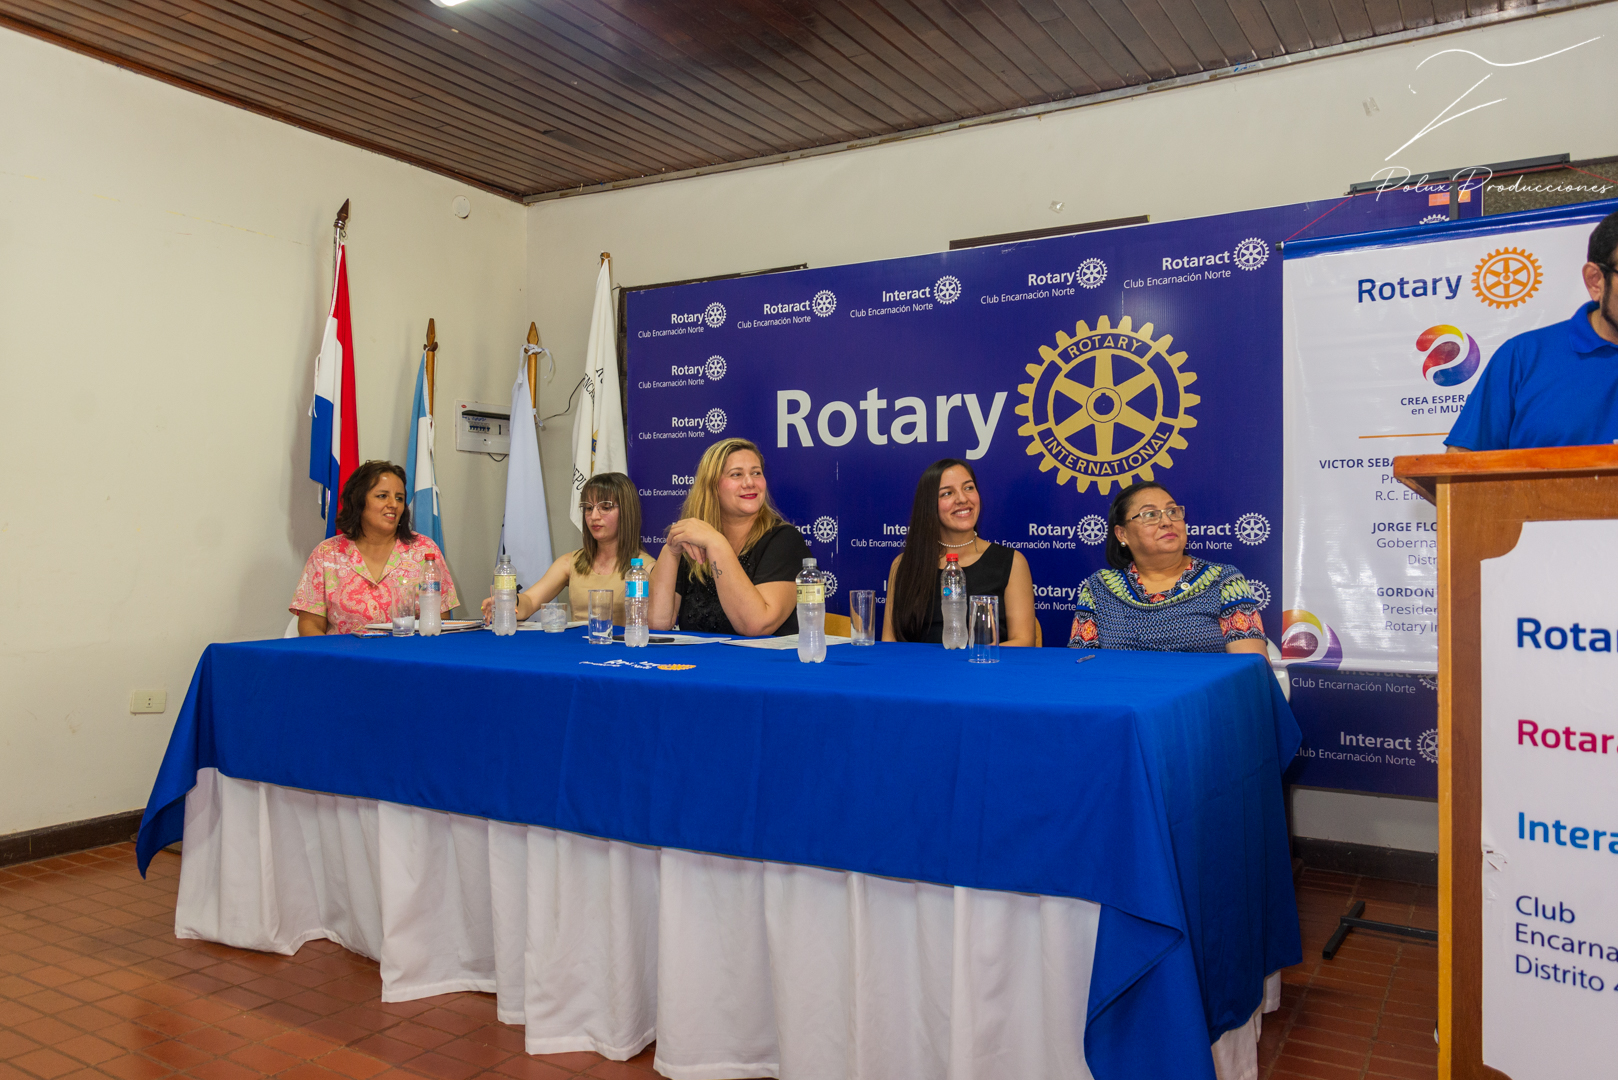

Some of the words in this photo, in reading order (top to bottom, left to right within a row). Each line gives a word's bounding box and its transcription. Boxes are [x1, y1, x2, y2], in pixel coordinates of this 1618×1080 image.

[1162, 251, 1230, 270] Rotaract
[1028, 272, 1075, 286] Rotary
[1124, 278, 1144, 289] Club
[1147, 273, 1202, 287] Encarnación
[1204, 270, 1232, 280] Norte
[882, 286, 930, 302] Interact
[980, 295, 999, 304] Club
[1001, 290, 1049, 302] Encarnación
[1052, 287, 1075, 297] Norte
[1358, 274, 1462, 303] Rotary
[764, 300, 810, 314] Rotaract
[850, 308, 866, 318] Club
[868, 304, 910, 316] Encarnación
[912, 302, 933, 311] Norte
[671, 313, 704, 324] Rotary
[737, 320, 752, 329] Club
[753, 317, 791, 328] Encarnación
[792, 315, 811, 323] Norte
[638, 330, 651, 338] Club
[652, 327, 686, 337] Encarnación
[688, 326, 704, 334] Norte
[1067, 335, 1142, 359] ROTARY
[671, 365, 704, 376] Rotary
[638, 381, 651, 389] Club
[688, 378, 704, 386] Norte
[1401, 397, 1428, 405] CREA
[1432, 394, 1470, 404] ESPER
[1428, 406, 1437, 414] el
[672, 417, 704, 429] Rotary
[777, 388, 1008, 460] Rotary
[639, 432, 651, 440] Club
[688, 430, 705, 438] Norte
[1044, 429, 1170, 476] INTERNATIONAL
[1319, 459, 1364, 469] VICTOR
[672, 475, 697, 485] Rota
[1375, 491, 1398, 501] R.C.
[1028, 523, 1076, 539] Rotary
[1371, 522, 1412, 534] JORGE
[851, 539, 867, 547] Club
[1053, 541, 1076, 549] Norte
[1206, 541, 1232, 549] Norte
[1377, 587, 1434, 597] GORDON
[1053, 602, 1076, 610] Norte
[1385, 621, 1427, 634] Rotary
[1516, 618, 1618, 653] Rota
[1292, 678, 1315, 688] Club
[1319, 679, 1382, 692] Encarnación
[1385, 683, 1416, 693] Norte
[1340, 732, 1412, 750] Interact
[1518, 719, 1618, 754] Rotar
[1319, 749, 1382, 764] Encarnación
[1385, 755, 1416, 766] Norte
[1515, 895, 1575, 924] Club
[1515, 923, 1618, 963] Encarna
[1515, 954, 1604, 992] Distrito
